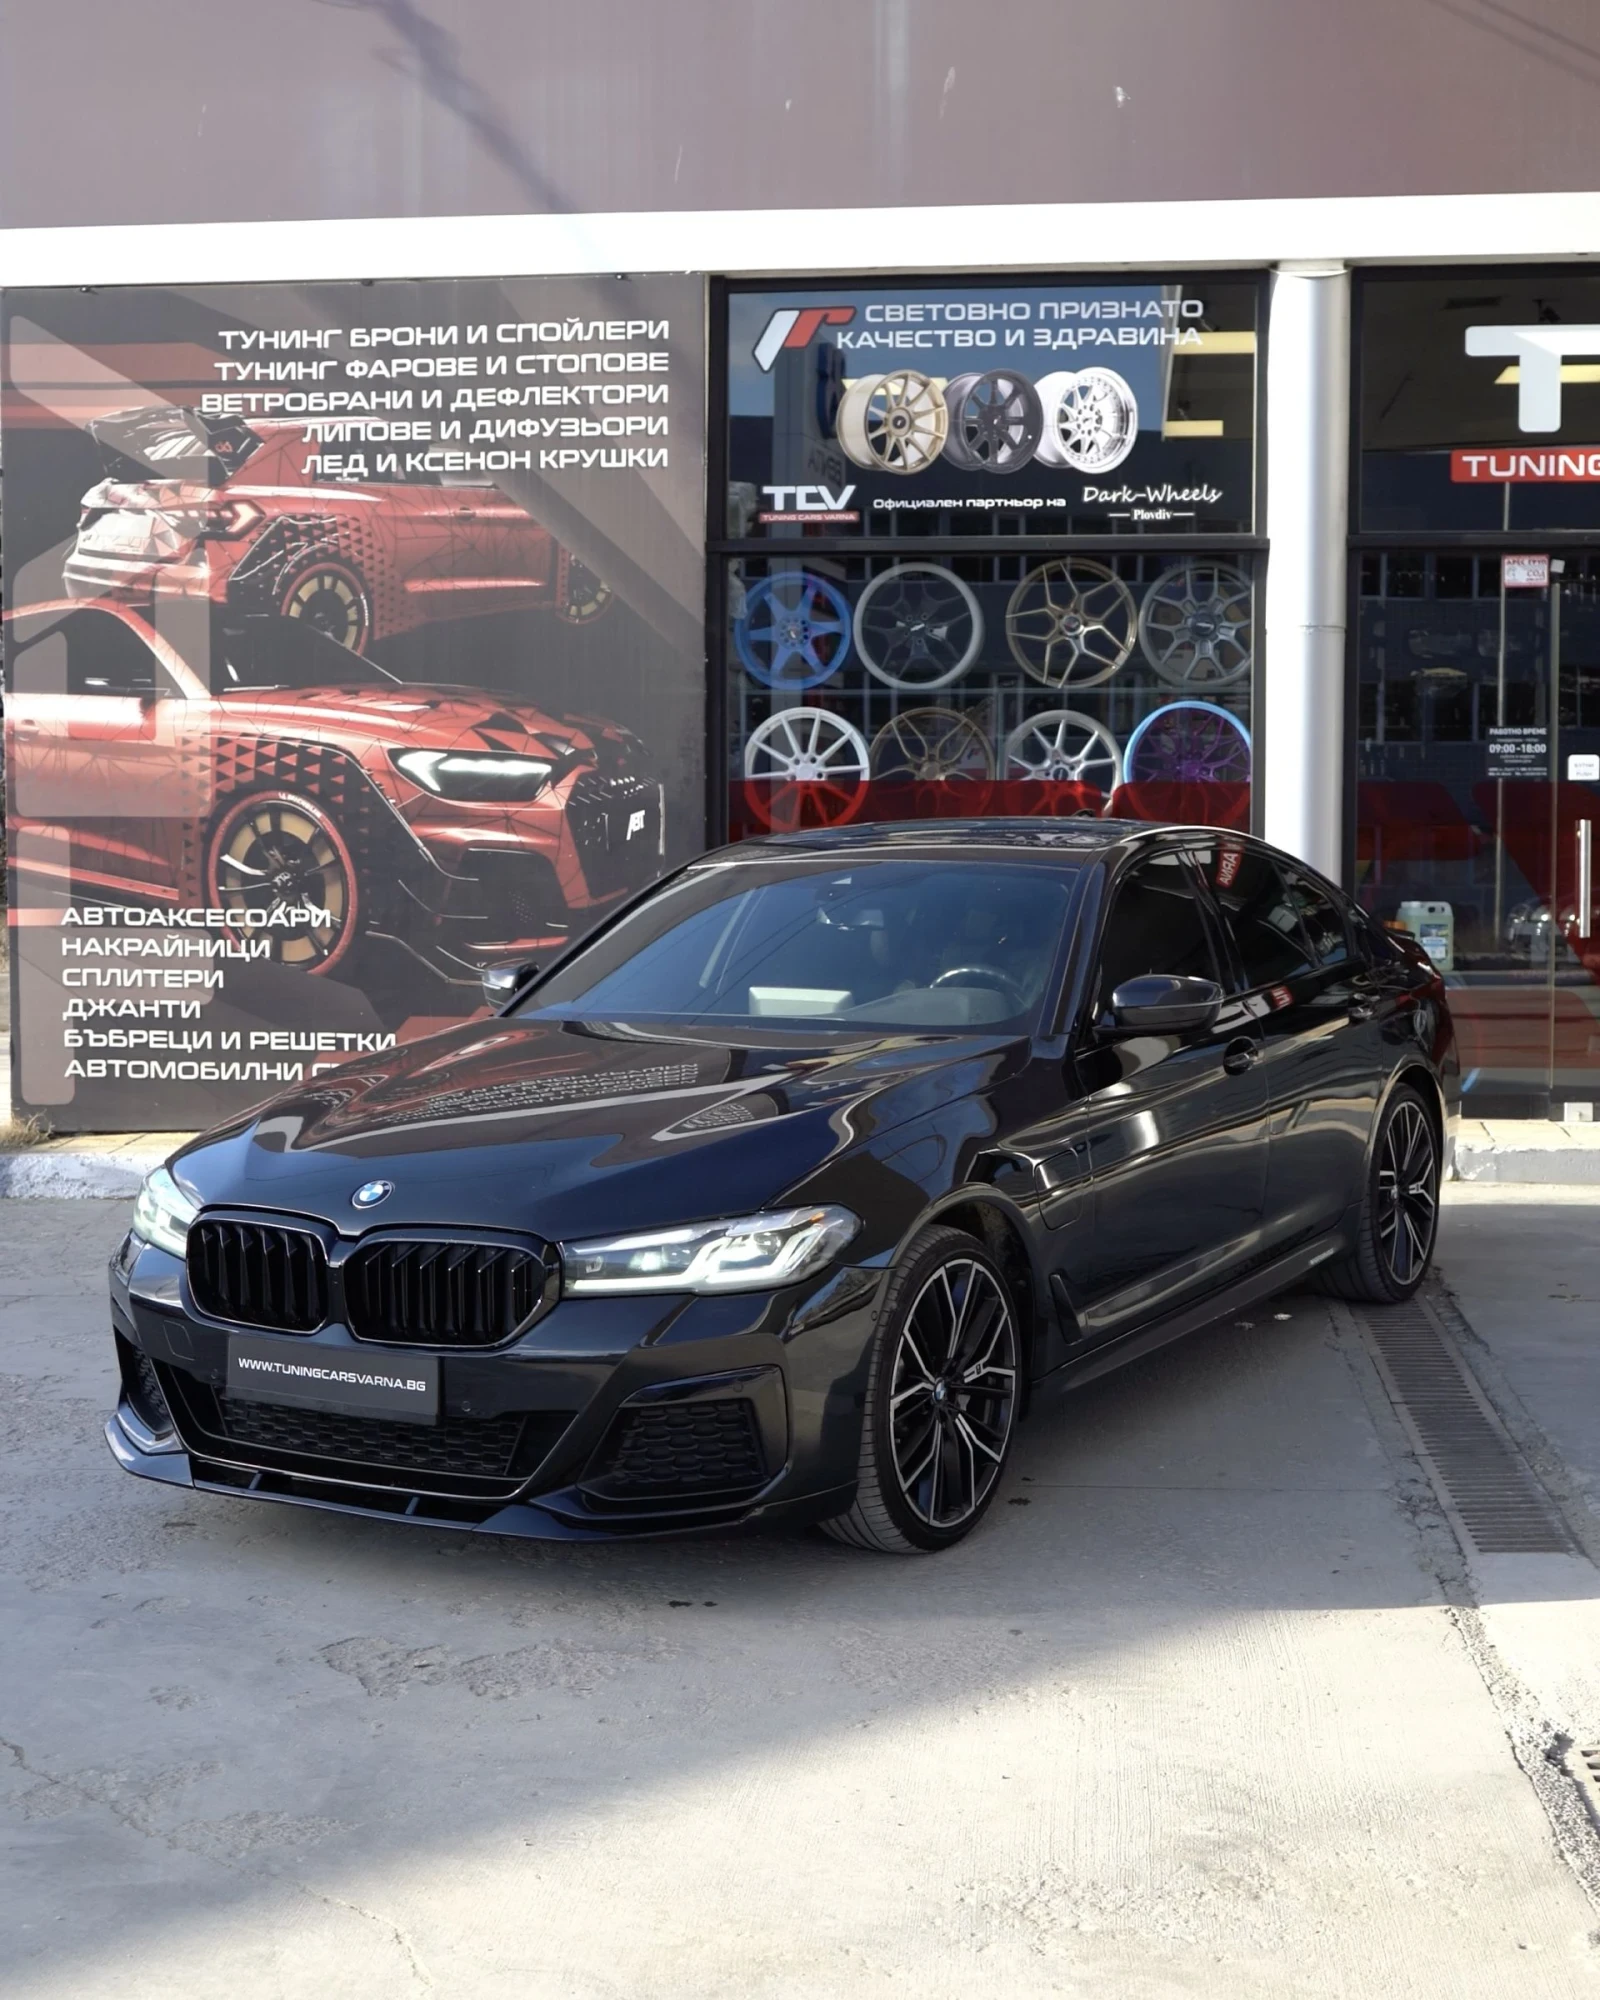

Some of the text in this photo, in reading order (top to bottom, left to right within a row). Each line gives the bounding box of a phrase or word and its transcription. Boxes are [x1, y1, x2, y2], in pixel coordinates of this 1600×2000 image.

[866, 301, 1203, 322] СВЕТОВНО ПРИЗНАТО
[219, 318, 669, 349] ТУНИНГ БРОНИ И СПОЙЛЕРИ
[838, 327, 1203, 350] КАЧЕСТВО И ЗДРАВИНА
[214, 353, 668, 380] ТУНИНГ ФАРОВЕ И СТОПОВЕ
[202, 385, 668, 413] ВЕТРОБРАНИ И ДЕФЛЕКТОРИ
[302, 416, 668, 443] ЛИПОВЕ И ДИФУЗЬОРИ
[302, 448, 668, 474] ЛЕД И КСЕНОН КРУШКИ
[763, 485, 855, 510] TCV
[874, 499, 962, 510] Официален
[966, 499, 1043, 509] партньор
[1084, 484, 1222, 502] Dark-Wheels
[1134, 509, 1171, 520] Plovdiv
[61, 907, 331, 927] АВТОАКСЕСОАРИ
[62, 935, 270, 961] НАКРАЙНИЦИ
[63, 968, 223, 988] СПЛИТЕРИ
[62, 999, 200, 1021] ДЖАНТИ
[64, 1029, 395, 1053] БЪБРЕЦИ И РЕШЕТКИ
[64, 1060, 302, 1080] АВТОМОБИЛНИ
[239, 1358, 425, 1391] WWW.TUNINGCARSVARNA.BG
